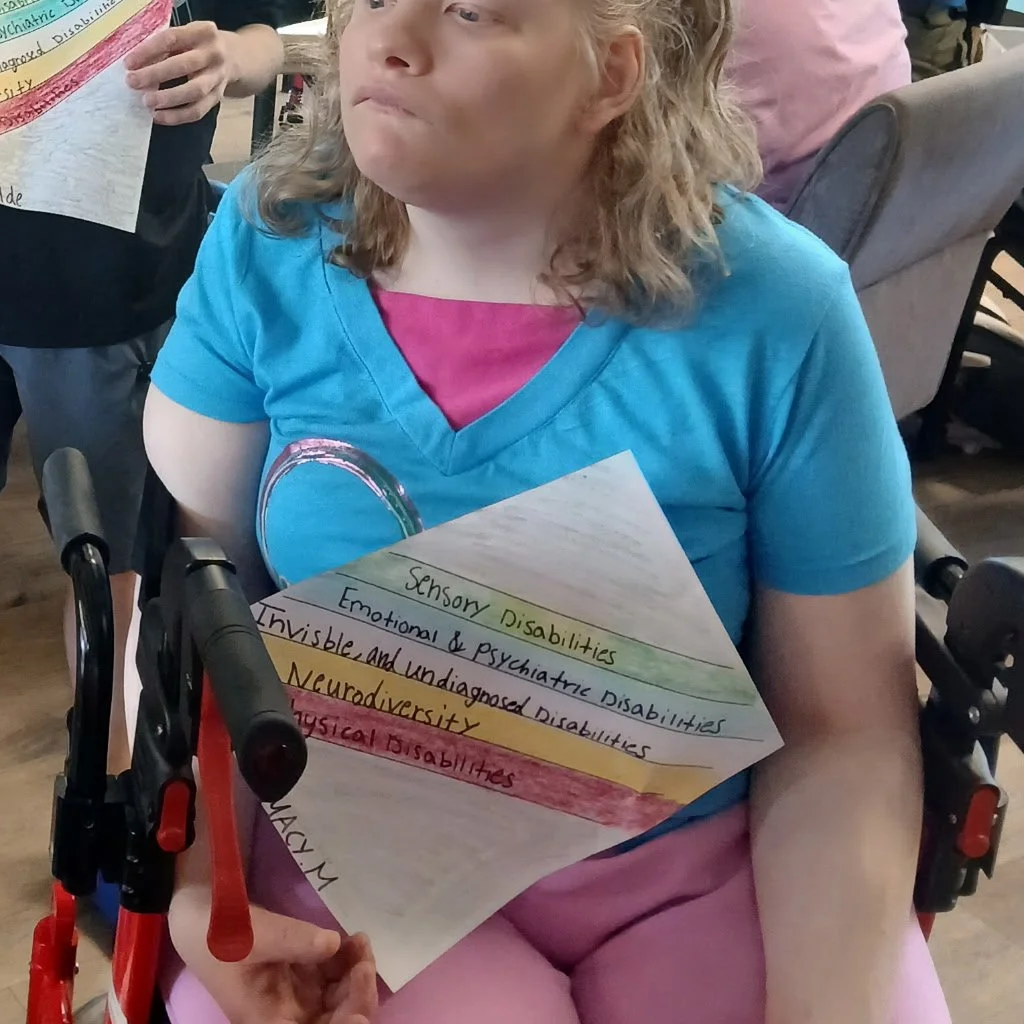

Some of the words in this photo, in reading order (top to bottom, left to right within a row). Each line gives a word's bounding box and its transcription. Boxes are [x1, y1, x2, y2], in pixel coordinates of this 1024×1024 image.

[337, 586, 438, 643] Emotional
[448, 630, 467, 655] &
[600, 690, 727, 735] Disabilities
[405, 566, 491, 619] Sensory
[500, 608, 618, 666] Disabilities
[286, 661, 481, 735] Neurodiversity
[290, 698, 376, 749] hysical
[365, 646, 404, 674] and
[406, 659, 532, 716] undiagnosed
[534, 706, 652, 760] Disabilities
